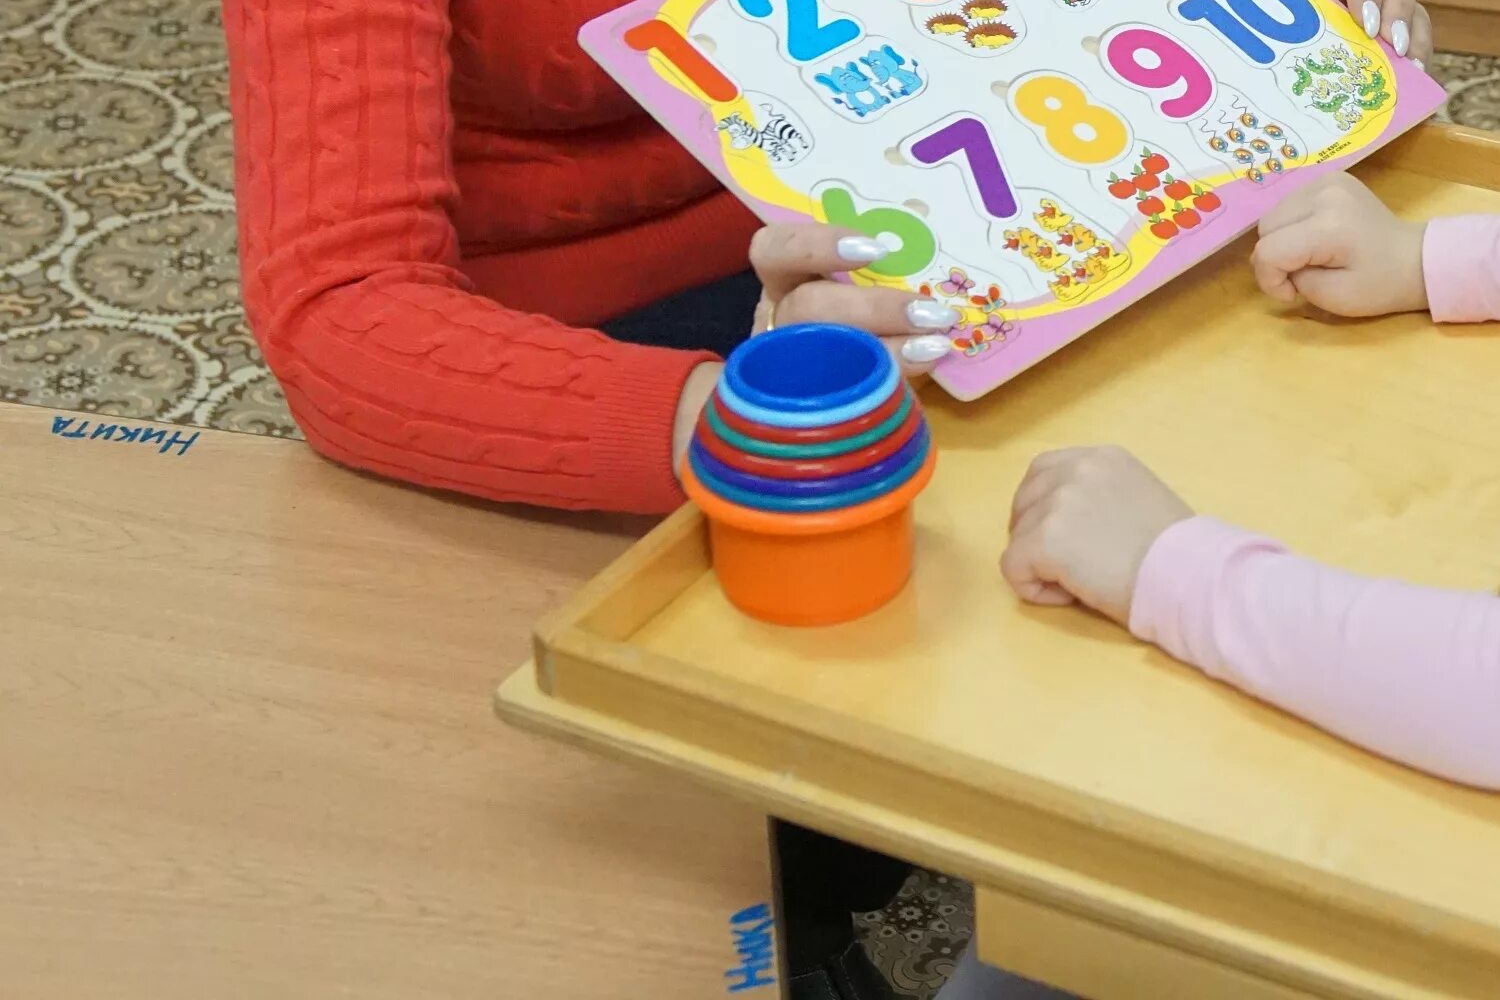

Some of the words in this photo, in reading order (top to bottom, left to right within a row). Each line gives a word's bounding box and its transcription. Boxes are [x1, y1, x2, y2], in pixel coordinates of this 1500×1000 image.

[624, 19, 738, 102] 1
[1107, 29, 1212, 118] 9
[1014, 76, 1128, 164] 8
[911, 118, 1018, 218] 7
[821, 187, 936, 277] 6
